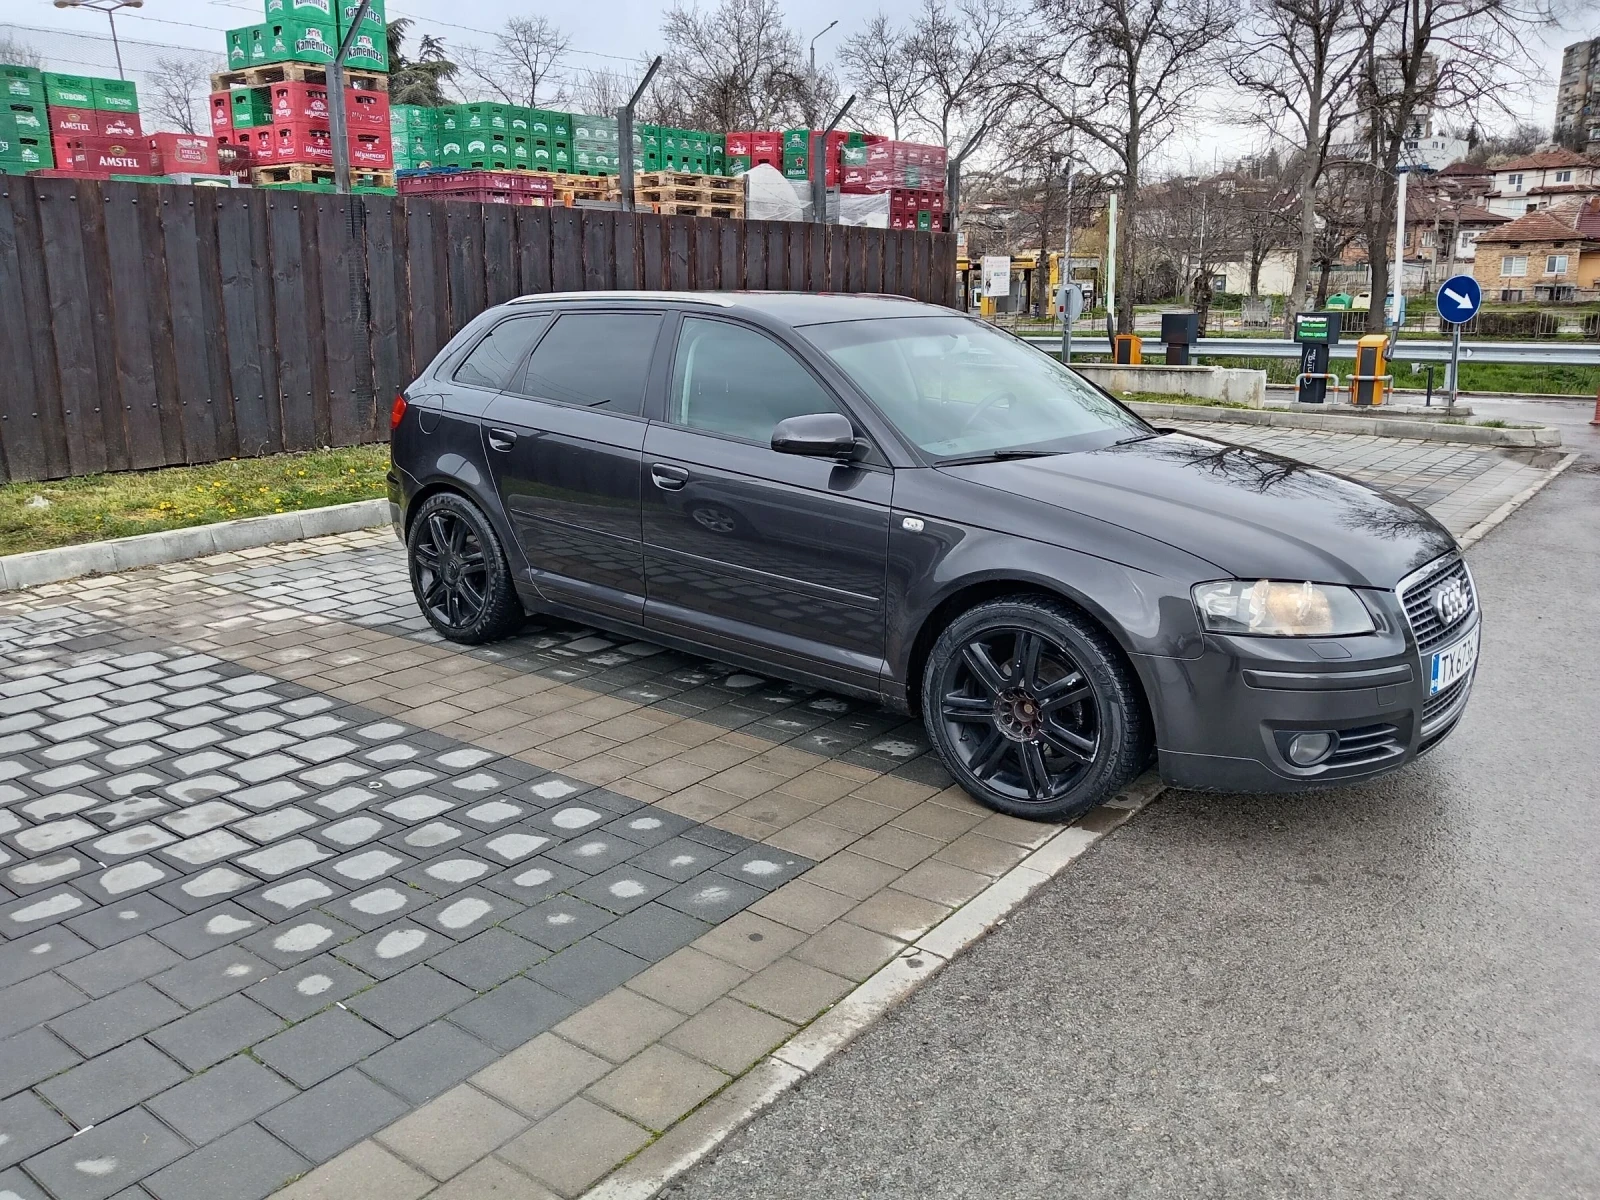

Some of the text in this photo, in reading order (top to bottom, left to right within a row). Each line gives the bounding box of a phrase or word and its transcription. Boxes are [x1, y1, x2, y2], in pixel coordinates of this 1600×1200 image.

[296, 40, 333, 57] Kamenitza
[348, 47, 383, 63] Kamenitza
[59, 92, 88, 102] TUBORG
[104, 97, 132, 106] TUBORG
[60, 121, 90, 131] AMSTEL
[99, 155, 140, 168] AMSTEL
